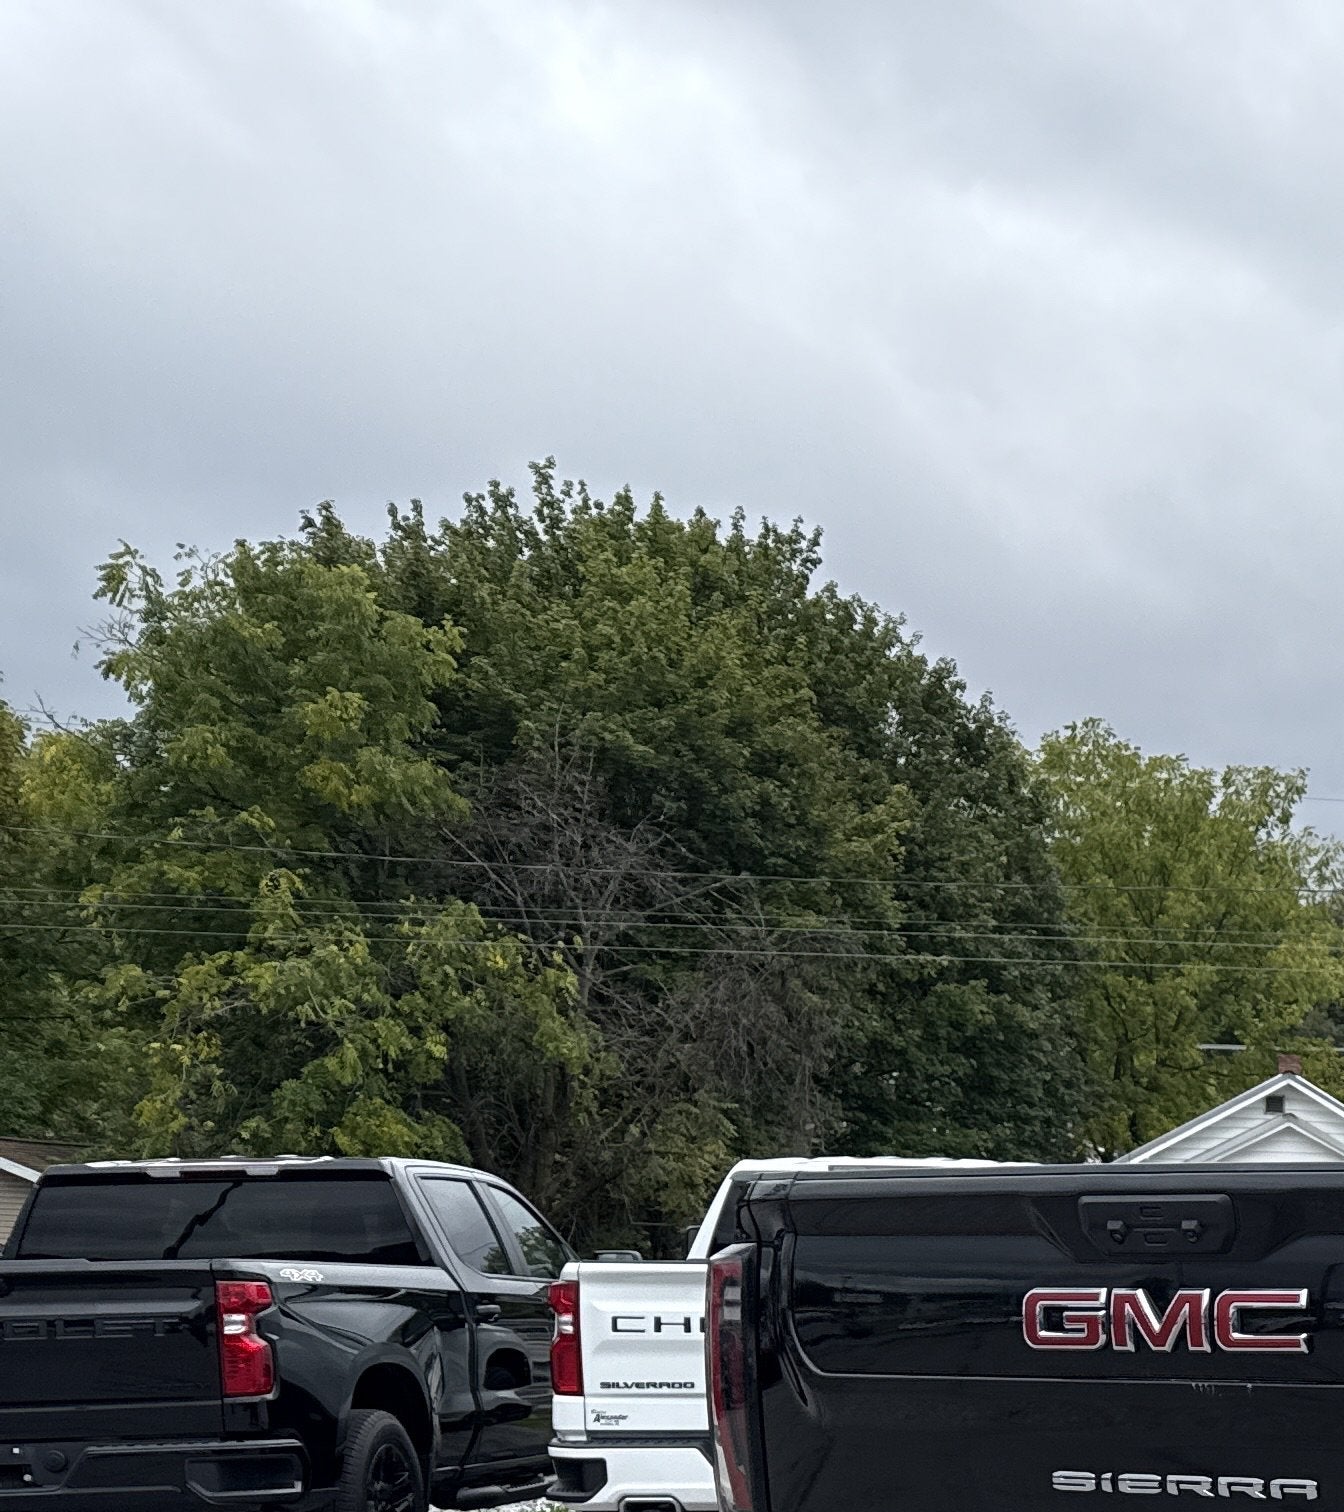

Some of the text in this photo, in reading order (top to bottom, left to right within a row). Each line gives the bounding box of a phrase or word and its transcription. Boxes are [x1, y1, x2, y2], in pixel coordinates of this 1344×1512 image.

[1022, 1287, 1309, 1354] GMC
[600, 1381, 695, 1389] SILVERADO
[1051, 1470, 1318, 1500] SIERRA
